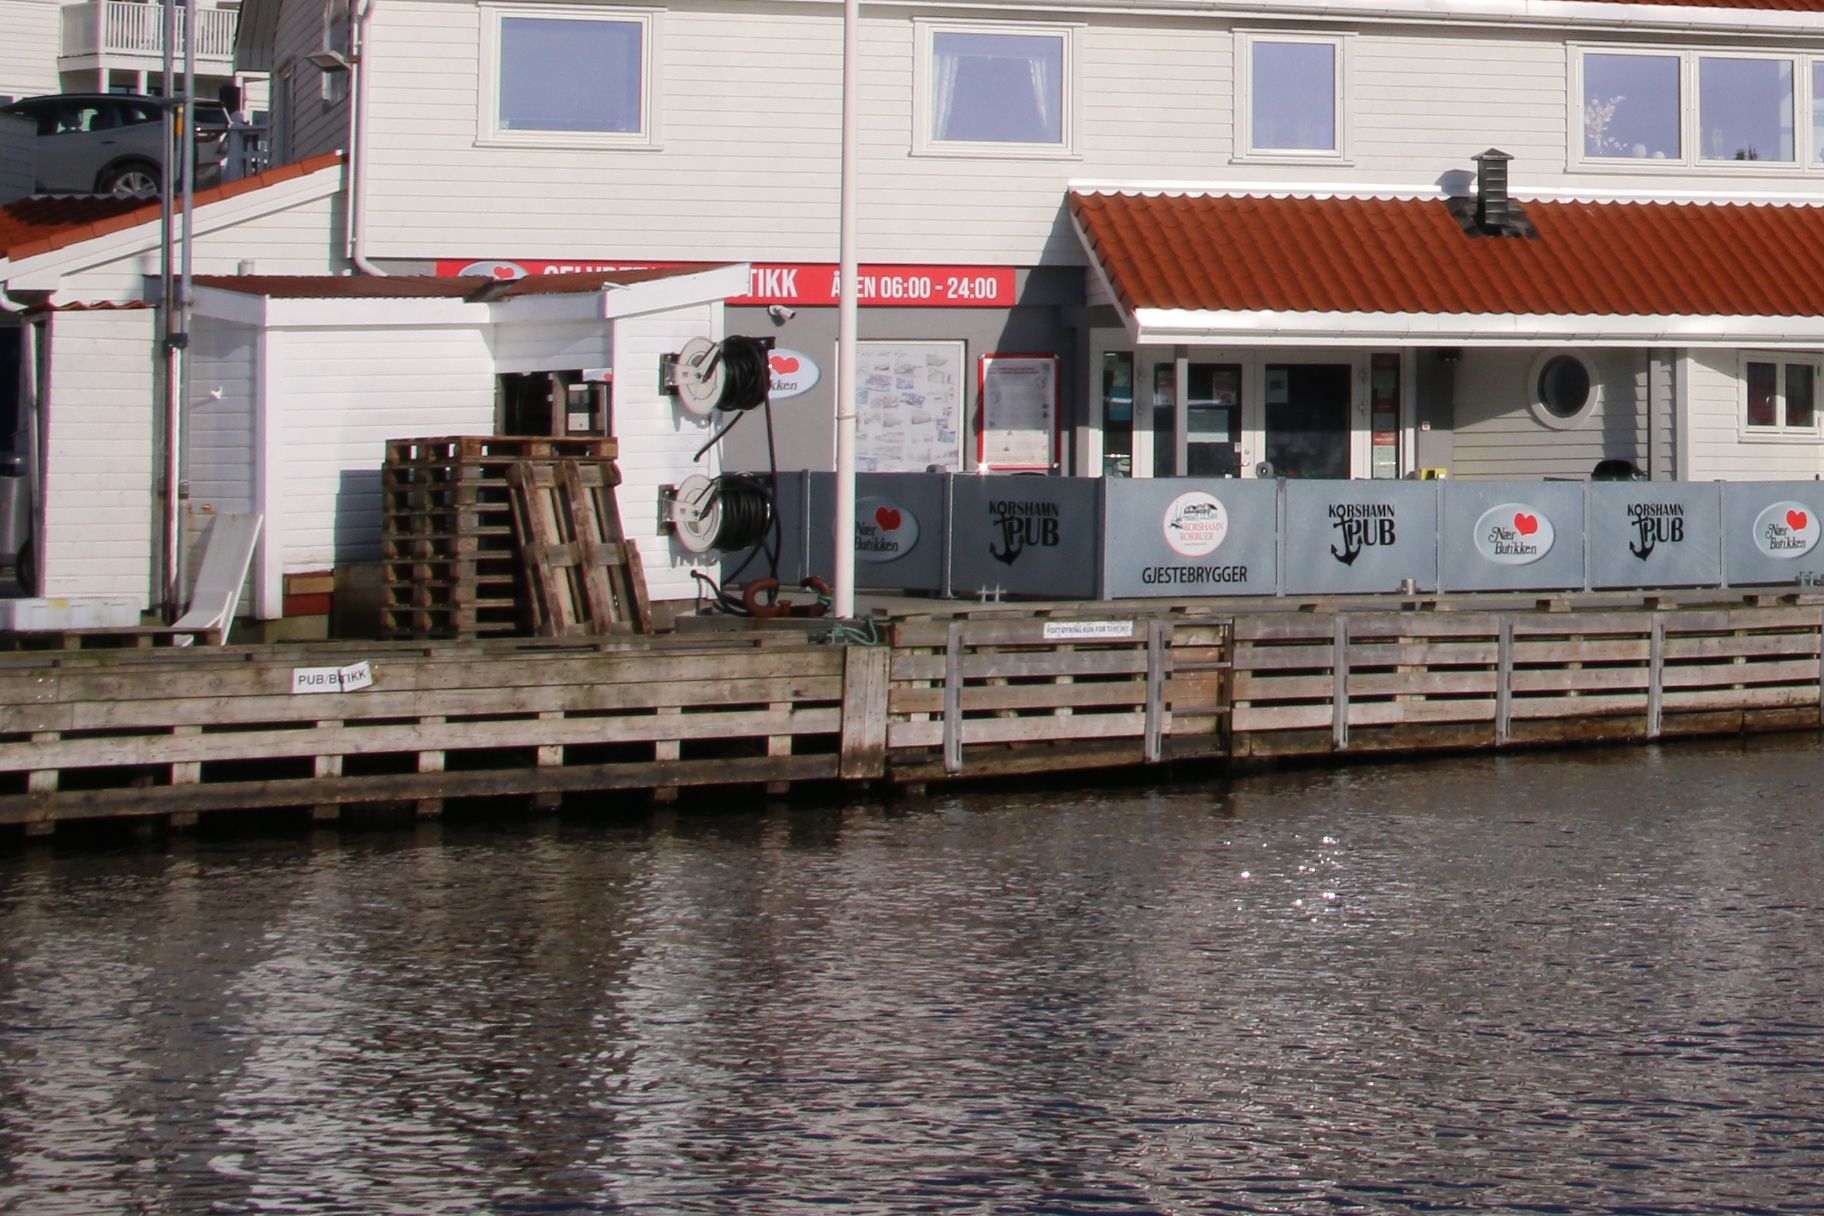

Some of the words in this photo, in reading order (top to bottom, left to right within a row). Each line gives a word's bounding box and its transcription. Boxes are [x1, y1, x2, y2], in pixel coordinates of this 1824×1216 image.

[748, 268, 798, 298] TIKK
[831, 271, 876, 298] ÅEN
[880, 276, 931, 299] 06:00
[947, 277, 997, 299] 24:00
[989, 501, 1059, 517] KORSHAMN
[1328, 504, 1395, 518] KORSHAMN
[1627, 504, 1684, 516] KORSHAMN
[1008, 516, 1060, 547] PUB
[1347, 518, 1396, 546] PUB
[1488, 526, 1516, 543] Nær
[1643, 516, 1684, 543] PUB
[1765, 523, 1787, 539] Nær
[1495, 541, 1537, 555] Butikken
[1769, 536, 1806, 550] Butikken
[1142, 566, 1248, 584] GJESTEBRYGGER
